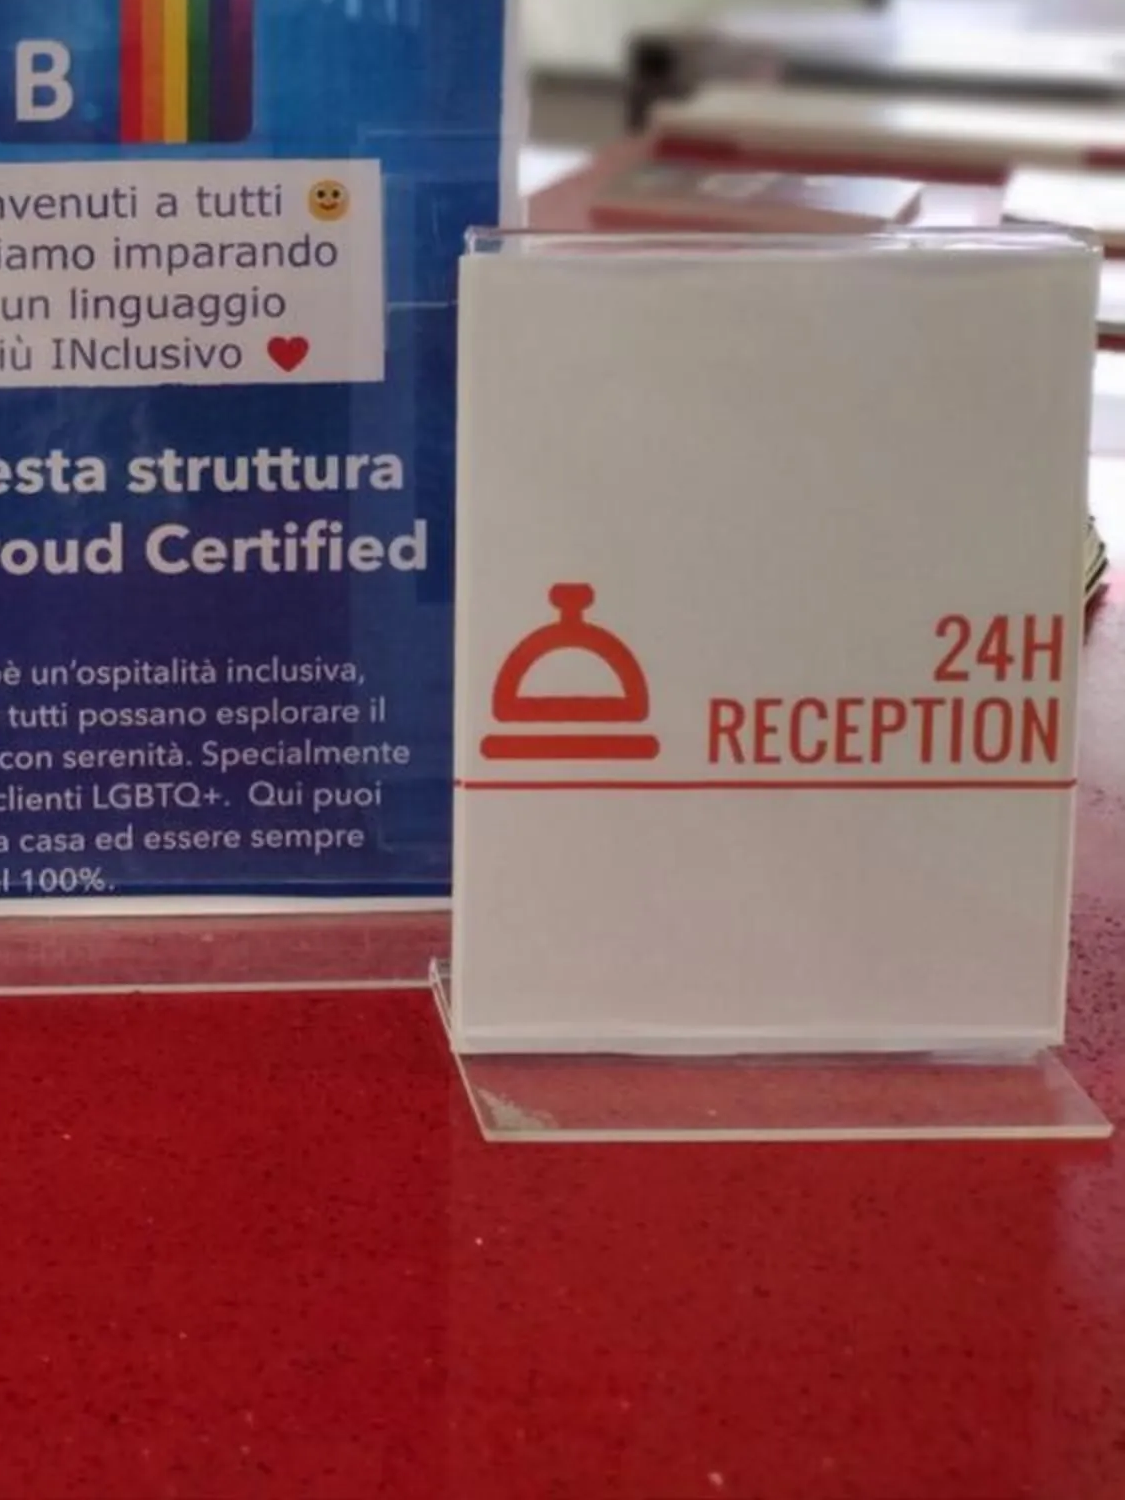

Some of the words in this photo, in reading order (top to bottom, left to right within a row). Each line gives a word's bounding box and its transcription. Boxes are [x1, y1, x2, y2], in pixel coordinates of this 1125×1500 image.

[15, 38, 74, 121] B
[155, 192, 178, 219] a
[195, 183, 282, 218] tutti
[114, 233, 338, 277] imparando
[1, 295, 50, 322] un
[70, 285, 287, 329] linguaggio
[52, 336, 243, 371] INclusivo
[126, 447, 404, 494] struttura
[145, 518, 427, 574] Certified
[933, 614, 1064, 682] 24H
[227, 656, 365, 686] inclusiva,
[7, 702, 68, 728] tutti
[78, 707, 207, 734] possano
[216, 697, 361, 732] esplorare
[370, 696, 386, 723] il
[708, 696, 1059, 765] RECEPTION
[62, 741, 192, 769] serenità.
[202, 739, 411, 773] Specialmente
[92, 781, 230, 810] LGBTQ+.
[248, 780, 303, 807] Qui
[313, 780, 382, 812] puoi
[19, 833, 85, 853] casa
[94, 824, 134, 851] ed
[143, 829, 241, 850] essere
[250, 828, 365, 855] sempre
[21, 866, 115, 893] 100%.
